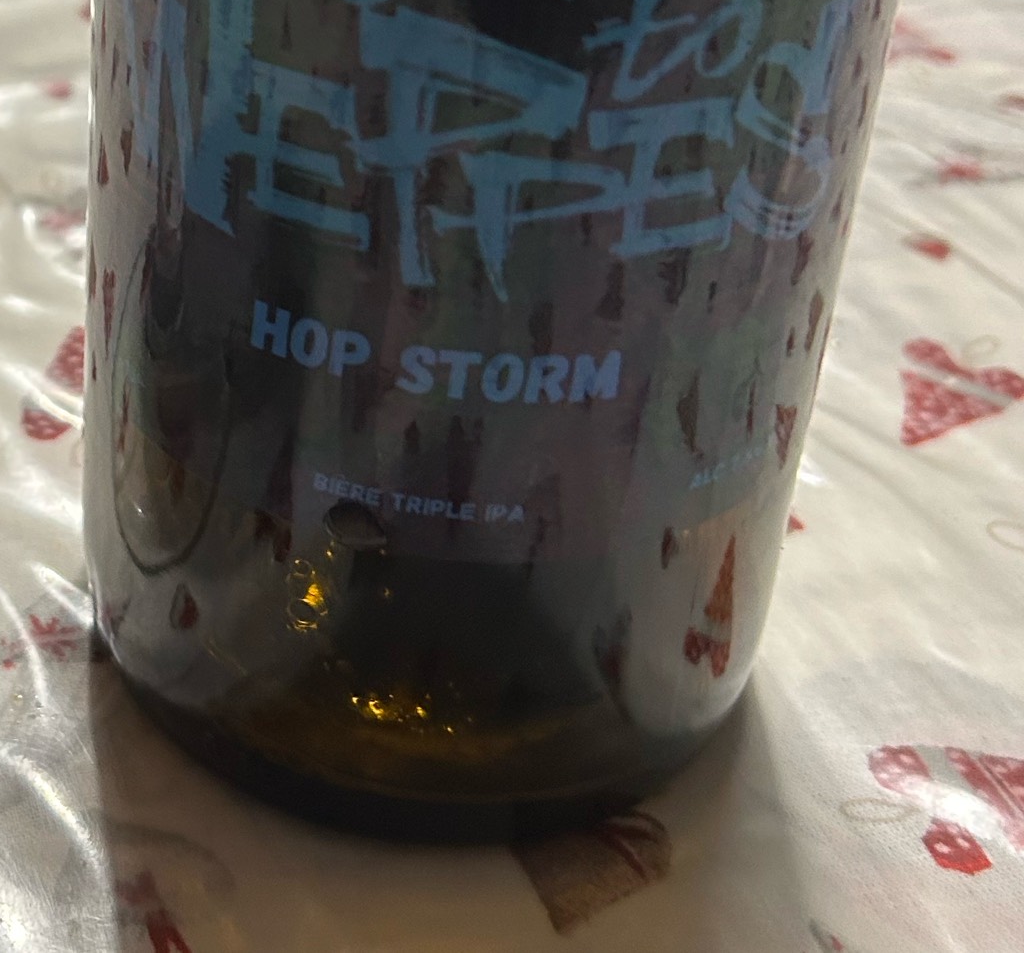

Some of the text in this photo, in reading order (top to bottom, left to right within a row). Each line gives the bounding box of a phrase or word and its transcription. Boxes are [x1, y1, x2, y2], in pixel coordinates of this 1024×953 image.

[250, 298, 623, 405] HOP STORM
[392, 490, 478, 522] TRIPLE
[484, 501, 525, 523] IPA
